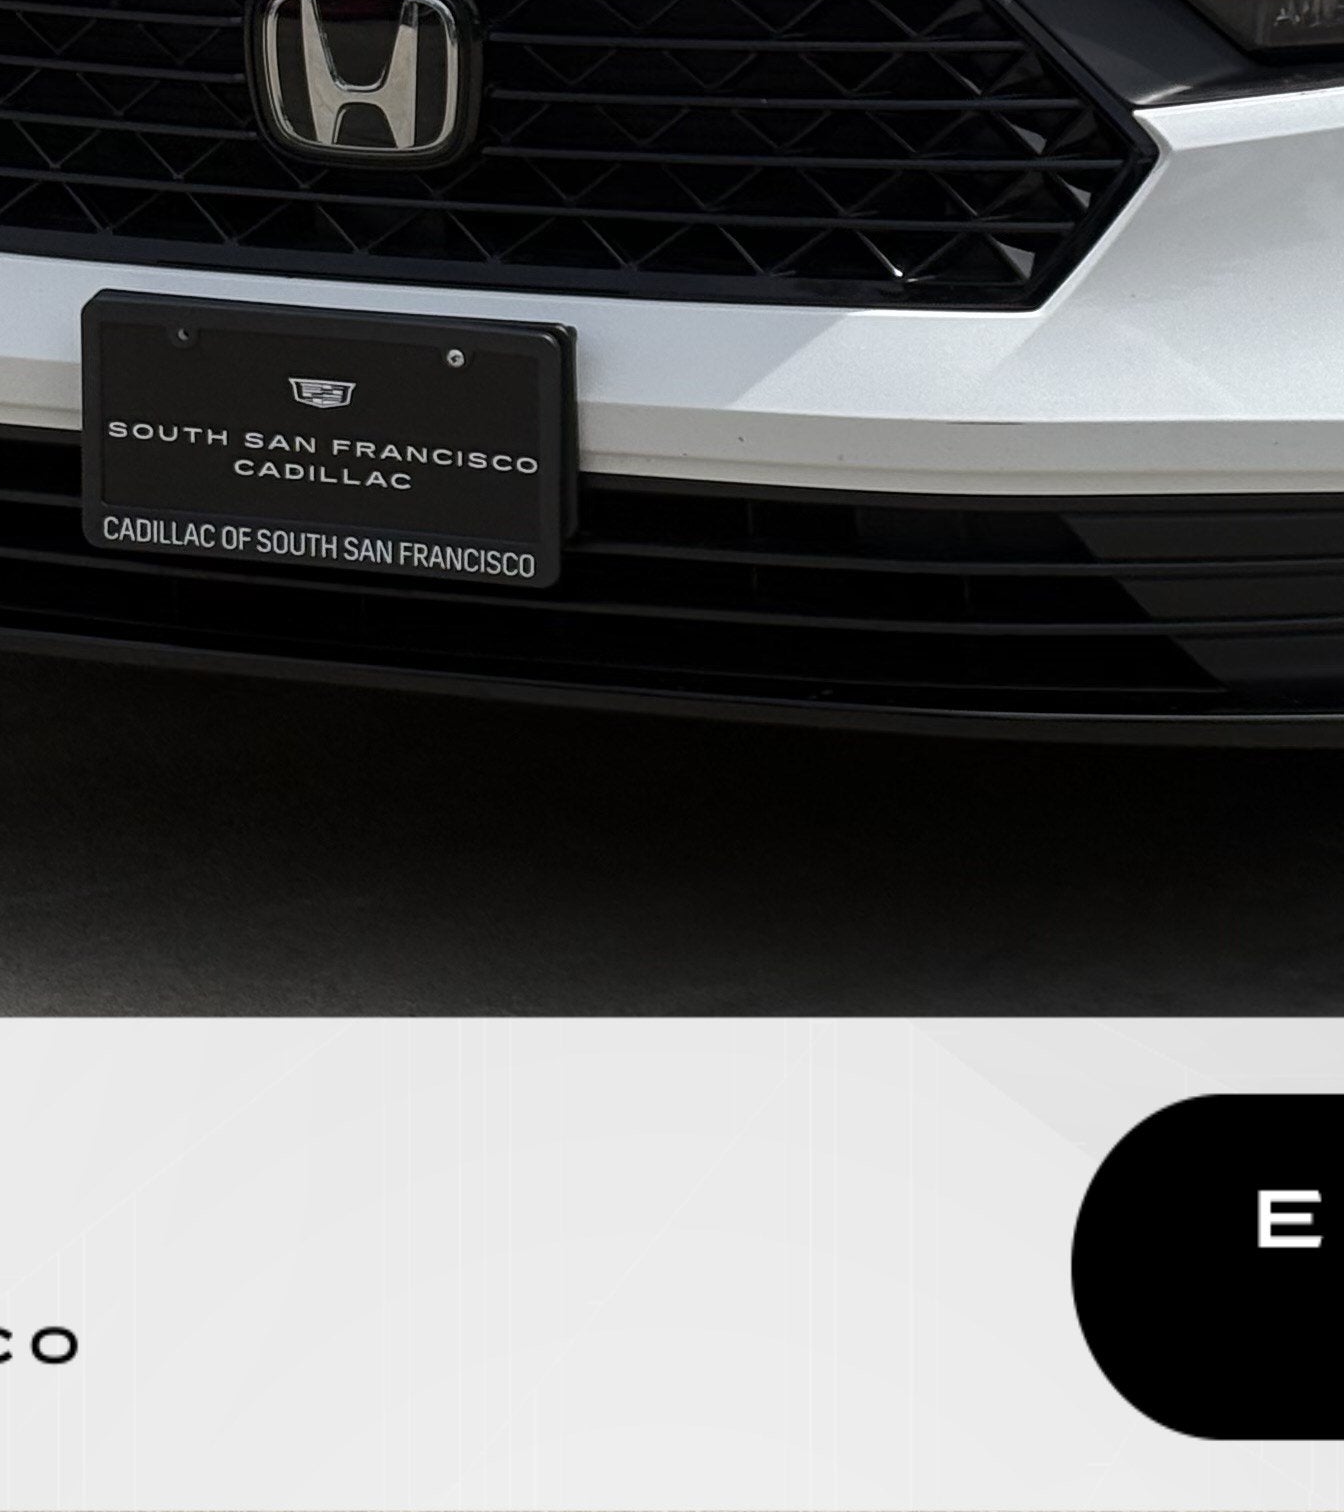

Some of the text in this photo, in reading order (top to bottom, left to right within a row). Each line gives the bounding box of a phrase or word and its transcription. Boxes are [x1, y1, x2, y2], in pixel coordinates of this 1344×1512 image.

[107, 420, 539, 475] SOUTH SAN FRANCISCO
[233, 458, 413, 491] CADILLAC
[102, 515, 536, 579] CADILLAC OF SOUTH SAN FRANCISCO
